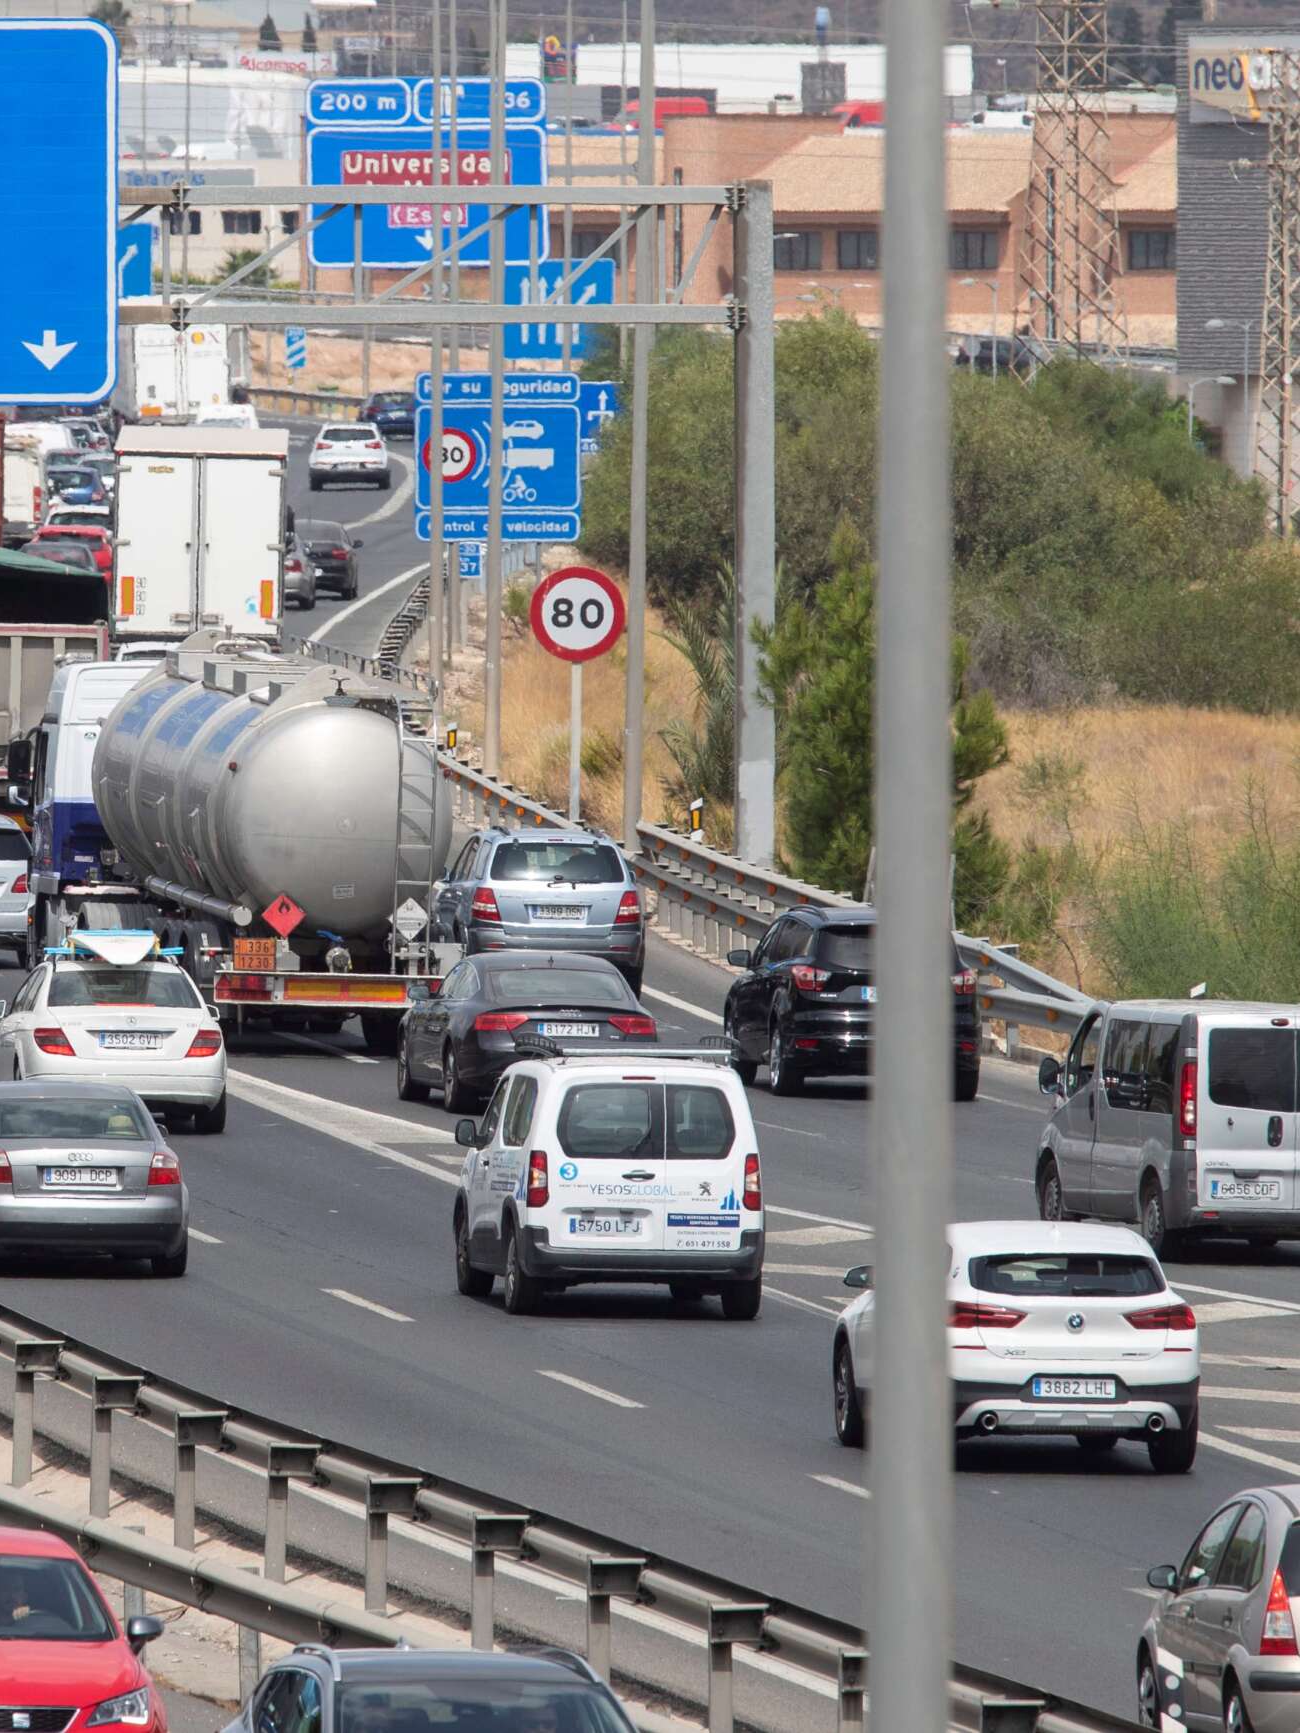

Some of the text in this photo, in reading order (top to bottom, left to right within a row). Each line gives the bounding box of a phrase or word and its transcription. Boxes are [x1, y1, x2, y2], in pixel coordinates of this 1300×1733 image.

[319, 93, 397, 110] 200 m
[344, 153, 509, 174] Universda
[394, 206, 462, 223] (Ese)
[424, 379, 572, 397] Pr su eguridad
[506, 519, 570, 532] velocidad
[551, 597, 605, 630] 80
[248, 941, 270, 954] 336
[240, 957, 270, 969] 1230
[546, 1023, 573, 1036] 8172
[107, 1033, 160, 1047] 3502 GVT
[54, 1169, 113, 1182] 9091 DCP
[578, 1219, 640, 1233] 5750 LFJ
[1044, 1380, 1112, 1396] 3882 LHL
